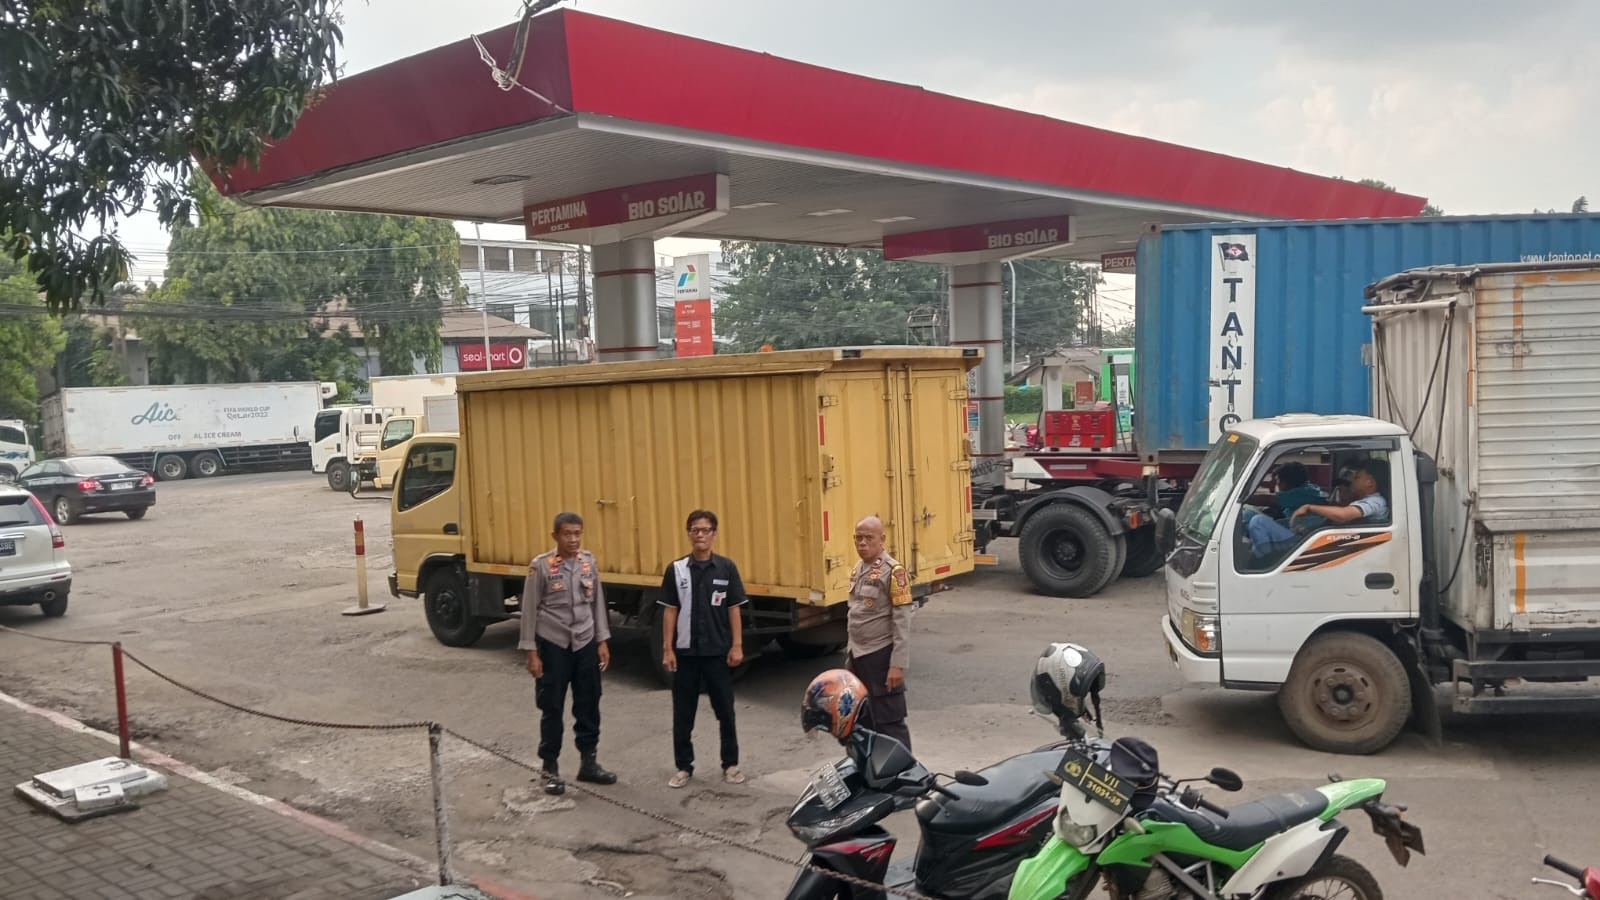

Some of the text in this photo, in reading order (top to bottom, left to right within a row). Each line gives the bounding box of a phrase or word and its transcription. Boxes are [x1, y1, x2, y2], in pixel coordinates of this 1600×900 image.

[531, 200, 588, 227] PERTAMINA
[628, 200, 655, 220] BIO
[551, 222, 571, 232] DEX
[988, 233, 1011, 249] BIO
[1104, 772, 1120, 788] VII
